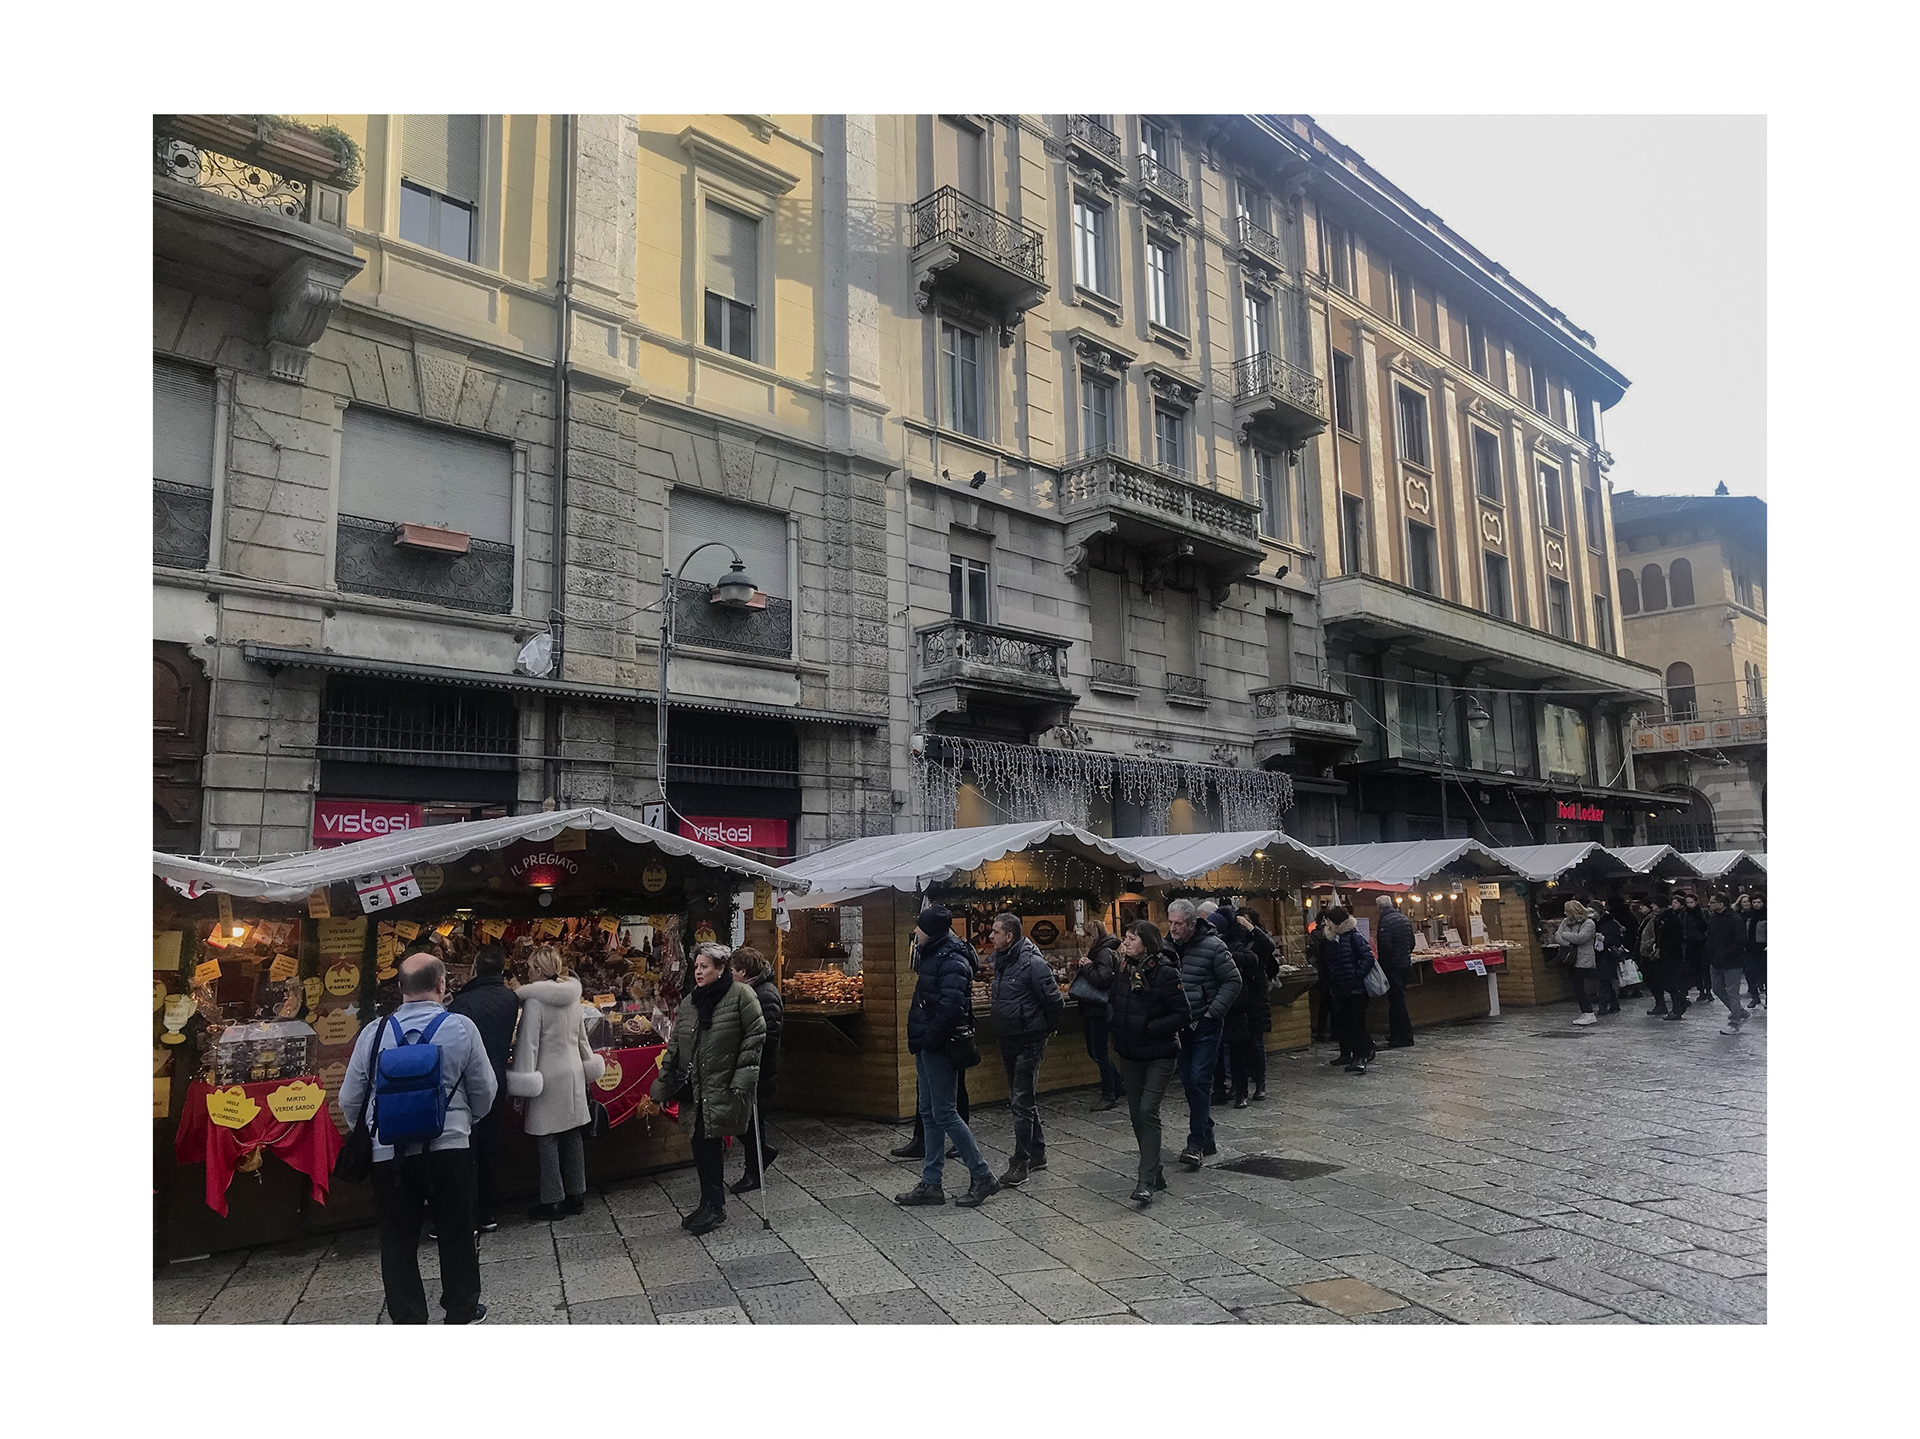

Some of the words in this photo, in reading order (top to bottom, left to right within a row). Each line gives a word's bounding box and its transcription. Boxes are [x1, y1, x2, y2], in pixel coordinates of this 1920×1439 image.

[1577, 803, 1604, 821] Locker
[510, 865, 523, 877] IL
[522, 853, 579, 875] PREGIATO
[286, 1095, 307, 1103] MIRTO
[223, 1106, 239, 1115] SARDO
[274, 1105, 294, 1113] VERDE
[294, 1103, 316, 1111] SARDO
